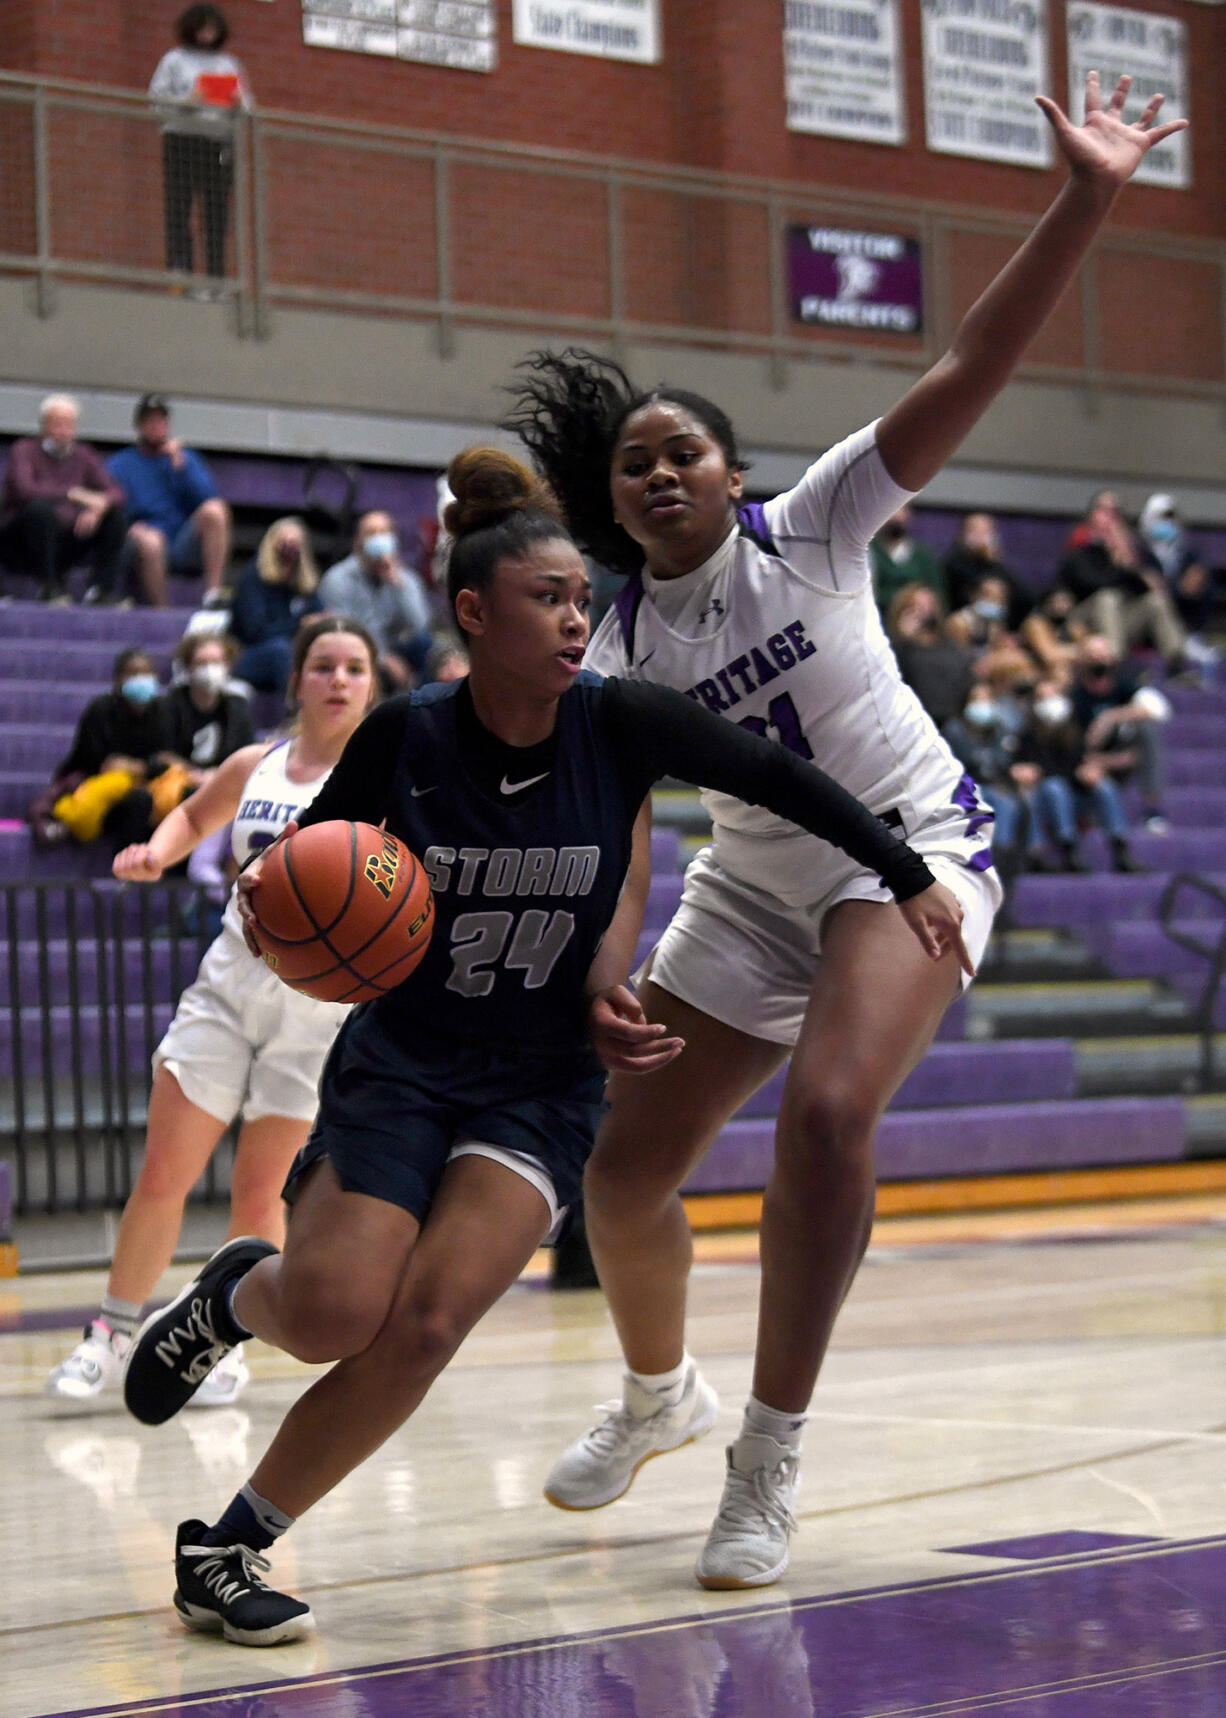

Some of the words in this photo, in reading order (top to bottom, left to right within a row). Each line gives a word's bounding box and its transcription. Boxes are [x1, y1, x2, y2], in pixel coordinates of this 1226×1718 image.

[808, 228, 904, 260] VISITOR
[801, 296, 917, 331] PARENTS
[684, 619, 817, 714] RITAGE
[423, 845, 600, 896] STORM
[445, 909, 575, 998] 24
